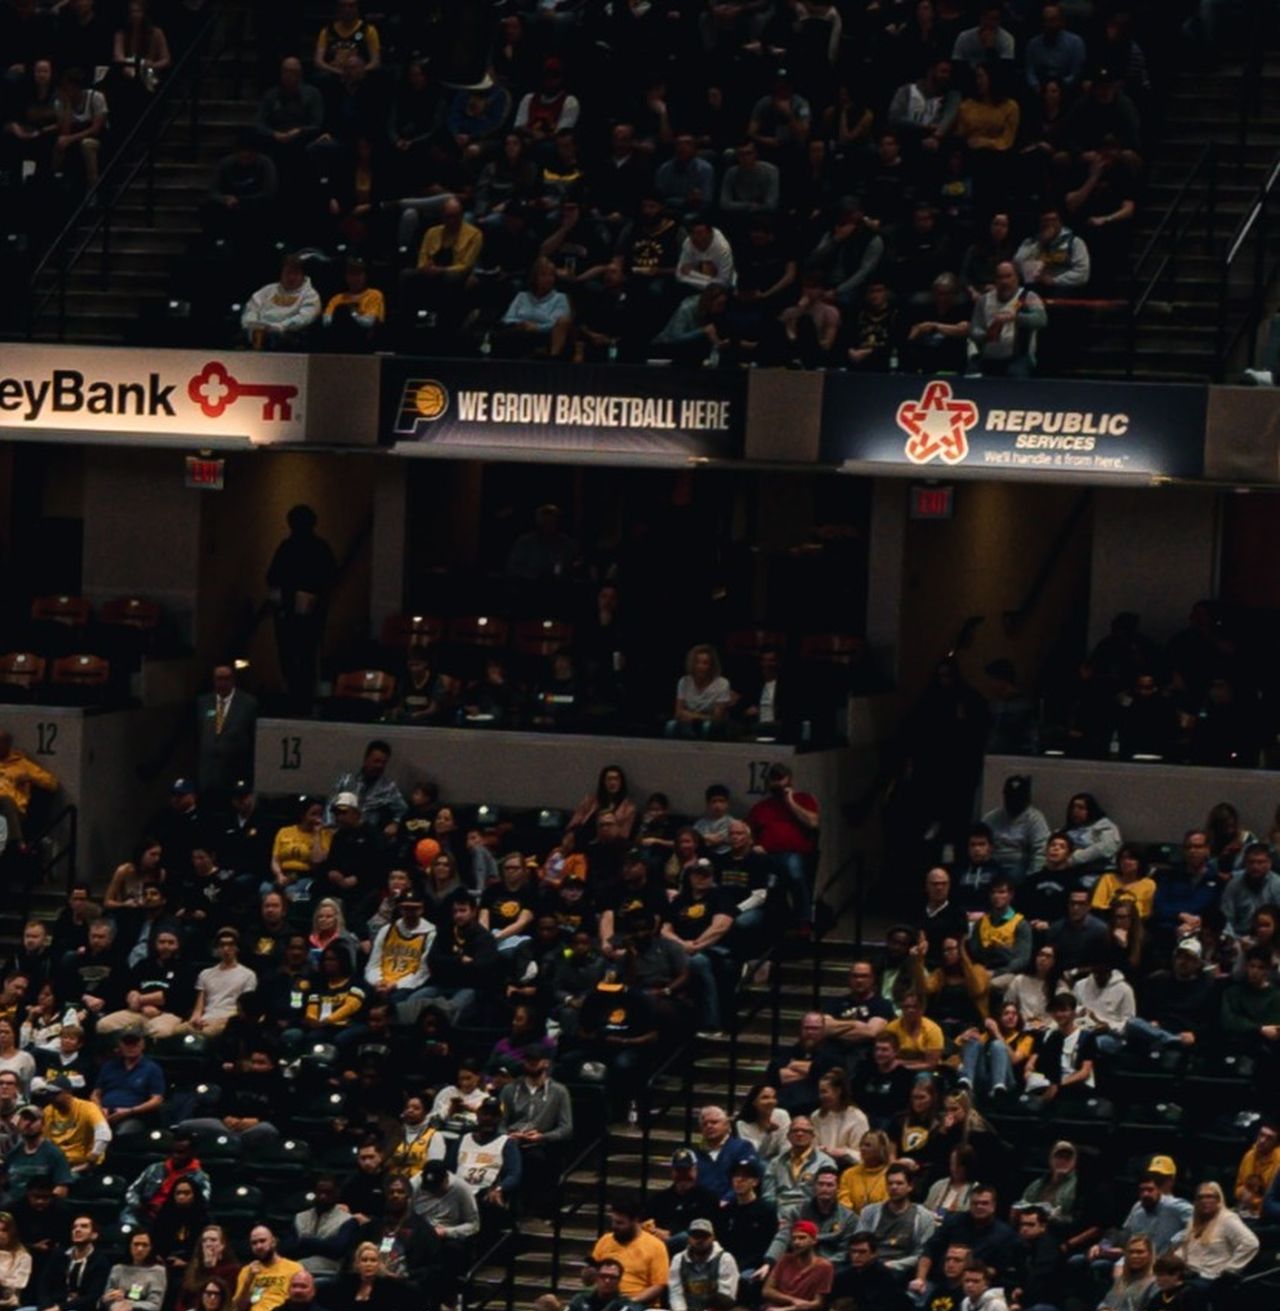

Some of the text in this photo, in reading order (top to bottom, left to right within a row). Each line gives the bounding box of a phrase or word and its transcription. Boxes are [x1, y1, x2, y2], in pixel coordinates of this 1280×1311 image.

[457, 391, 731, 431] WE GROW BASKETBALL HERE
[985, 410, 1130, 436] REPUBLIC
[1015, 434, 1095, 451] SERVICES
[36, 722, 57, 756] 12
[280, 737, 302, 770] 13
